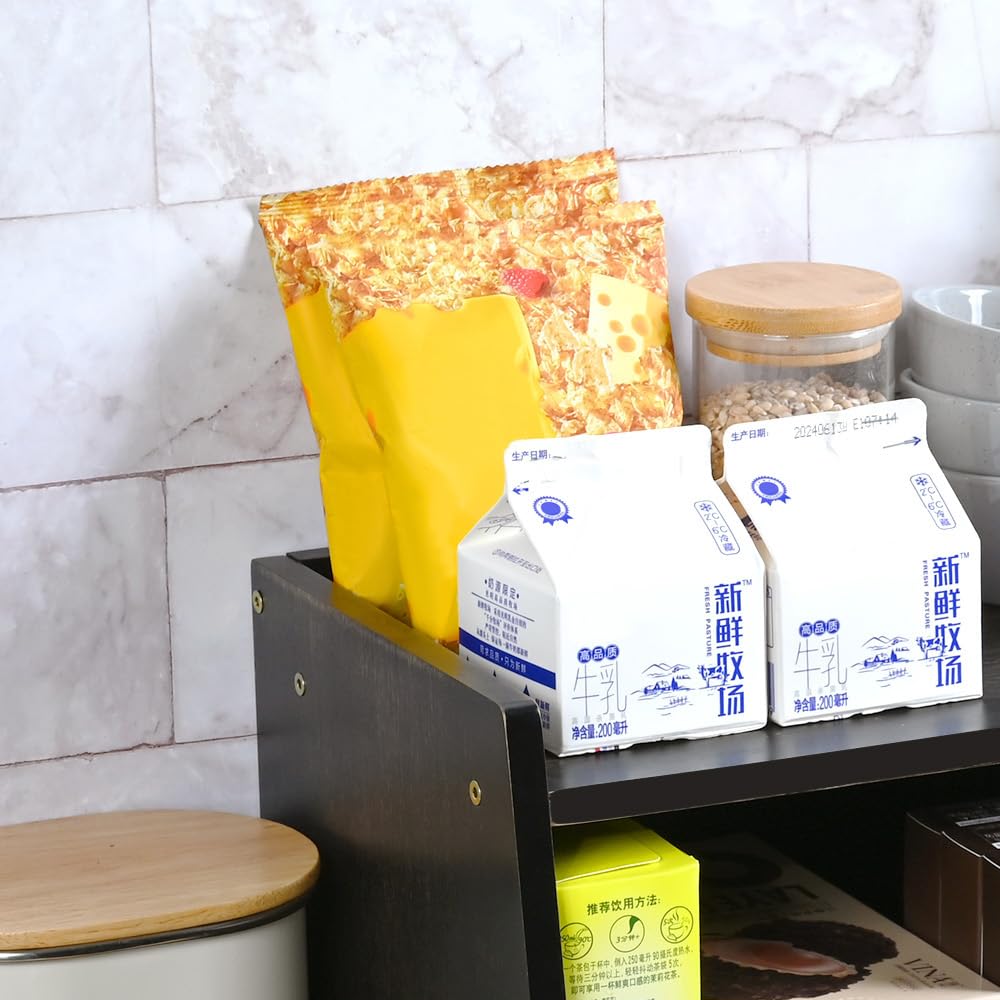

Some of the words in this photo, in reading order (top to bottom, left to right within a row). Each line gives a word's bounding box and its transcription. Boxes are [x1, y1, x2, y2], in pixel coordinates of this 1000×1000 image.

[800, 620, 839, 636] 高品质
[923, 591, 931, 629] PASTURE
[932, 554, 962, 688] 新鲜牧场
[579, 645, 618, 663] 高品质
[713, 581, 744, 717] 新鲜牧场
[793, 634, 848, 690] 牛乳
[572, 660, 628, 716] 牛乳
